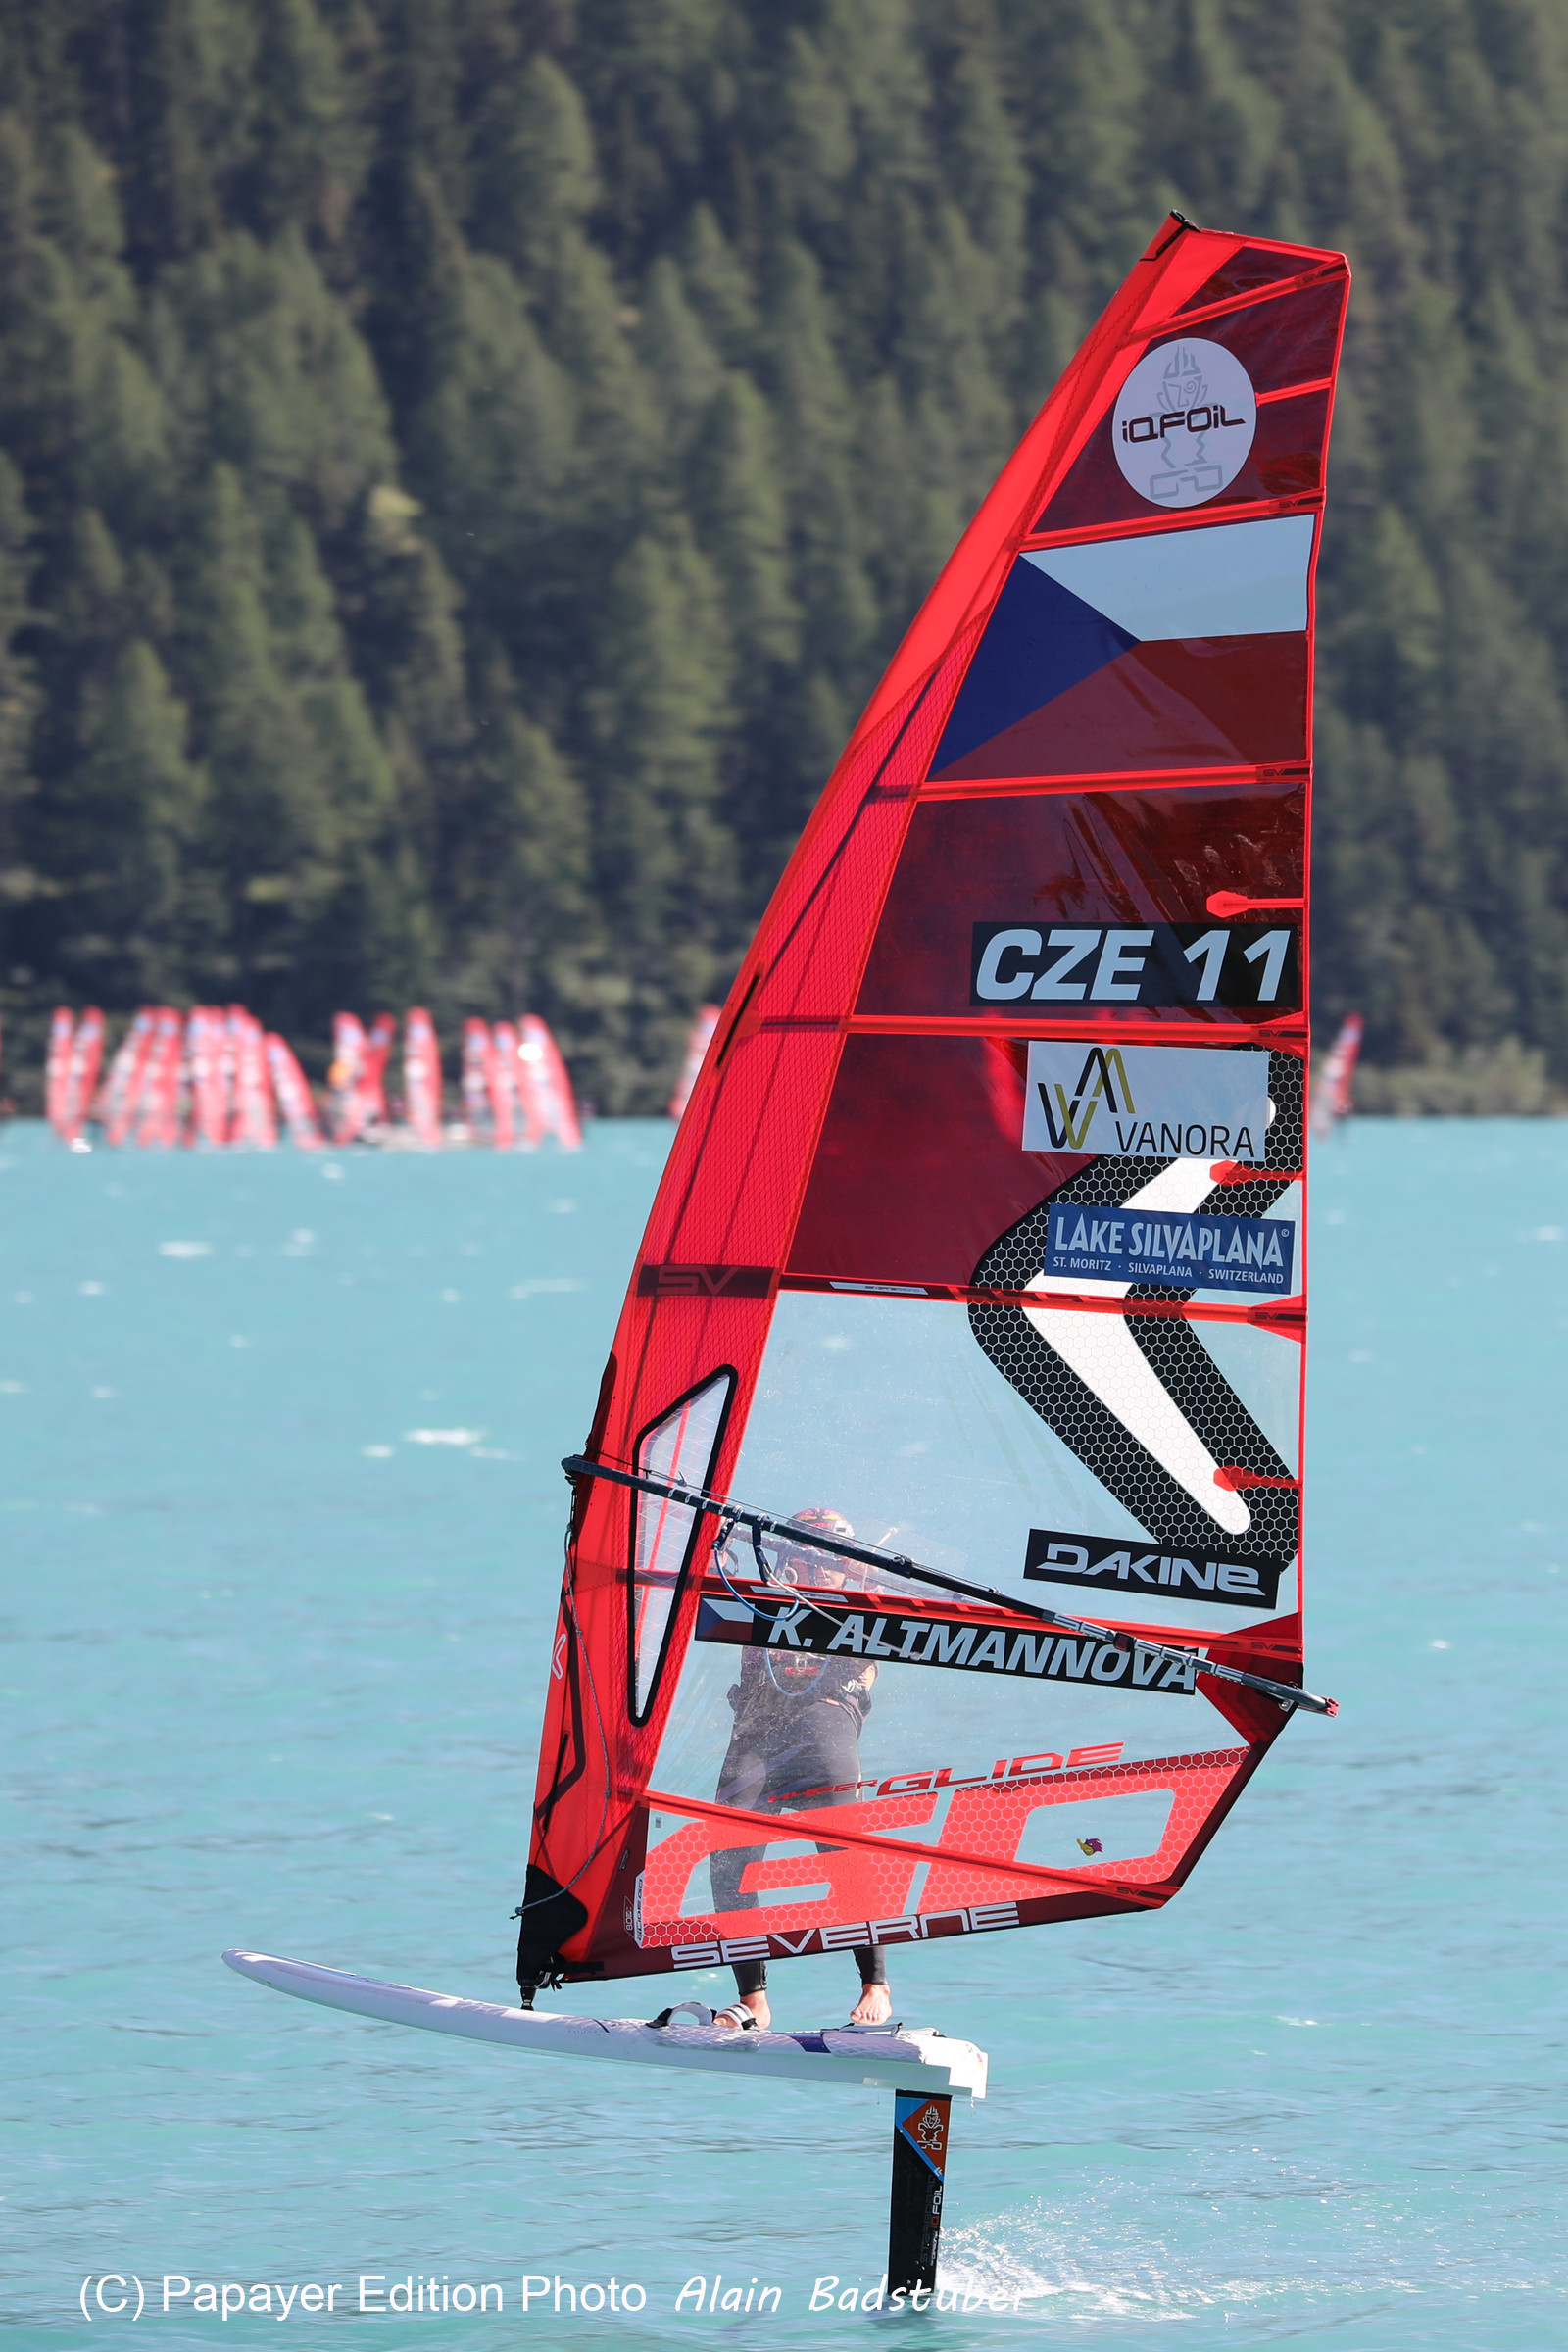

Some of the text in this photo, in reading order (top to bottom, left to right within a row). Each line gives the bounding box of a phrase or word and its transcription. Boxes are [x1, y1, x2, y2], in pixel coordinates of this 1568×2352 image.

[976, 928, 1291, 1002] CZE 11
[1115, 1120, 1254, 1157] VANORA
[1054, 1213, 1123, 1255] LAKE
[1128, 1220, 1284, 1270] SILVAPLANA
[1053, 1256, 1284, 1284] ST. MORITZ SILVAPLANA SWITZERLAND
[767, 1606, 813, 1647] K.
[876, 1741, 1125, 1797] GLIDE
[671, 1902, 1020, 1969] SEVERNE
